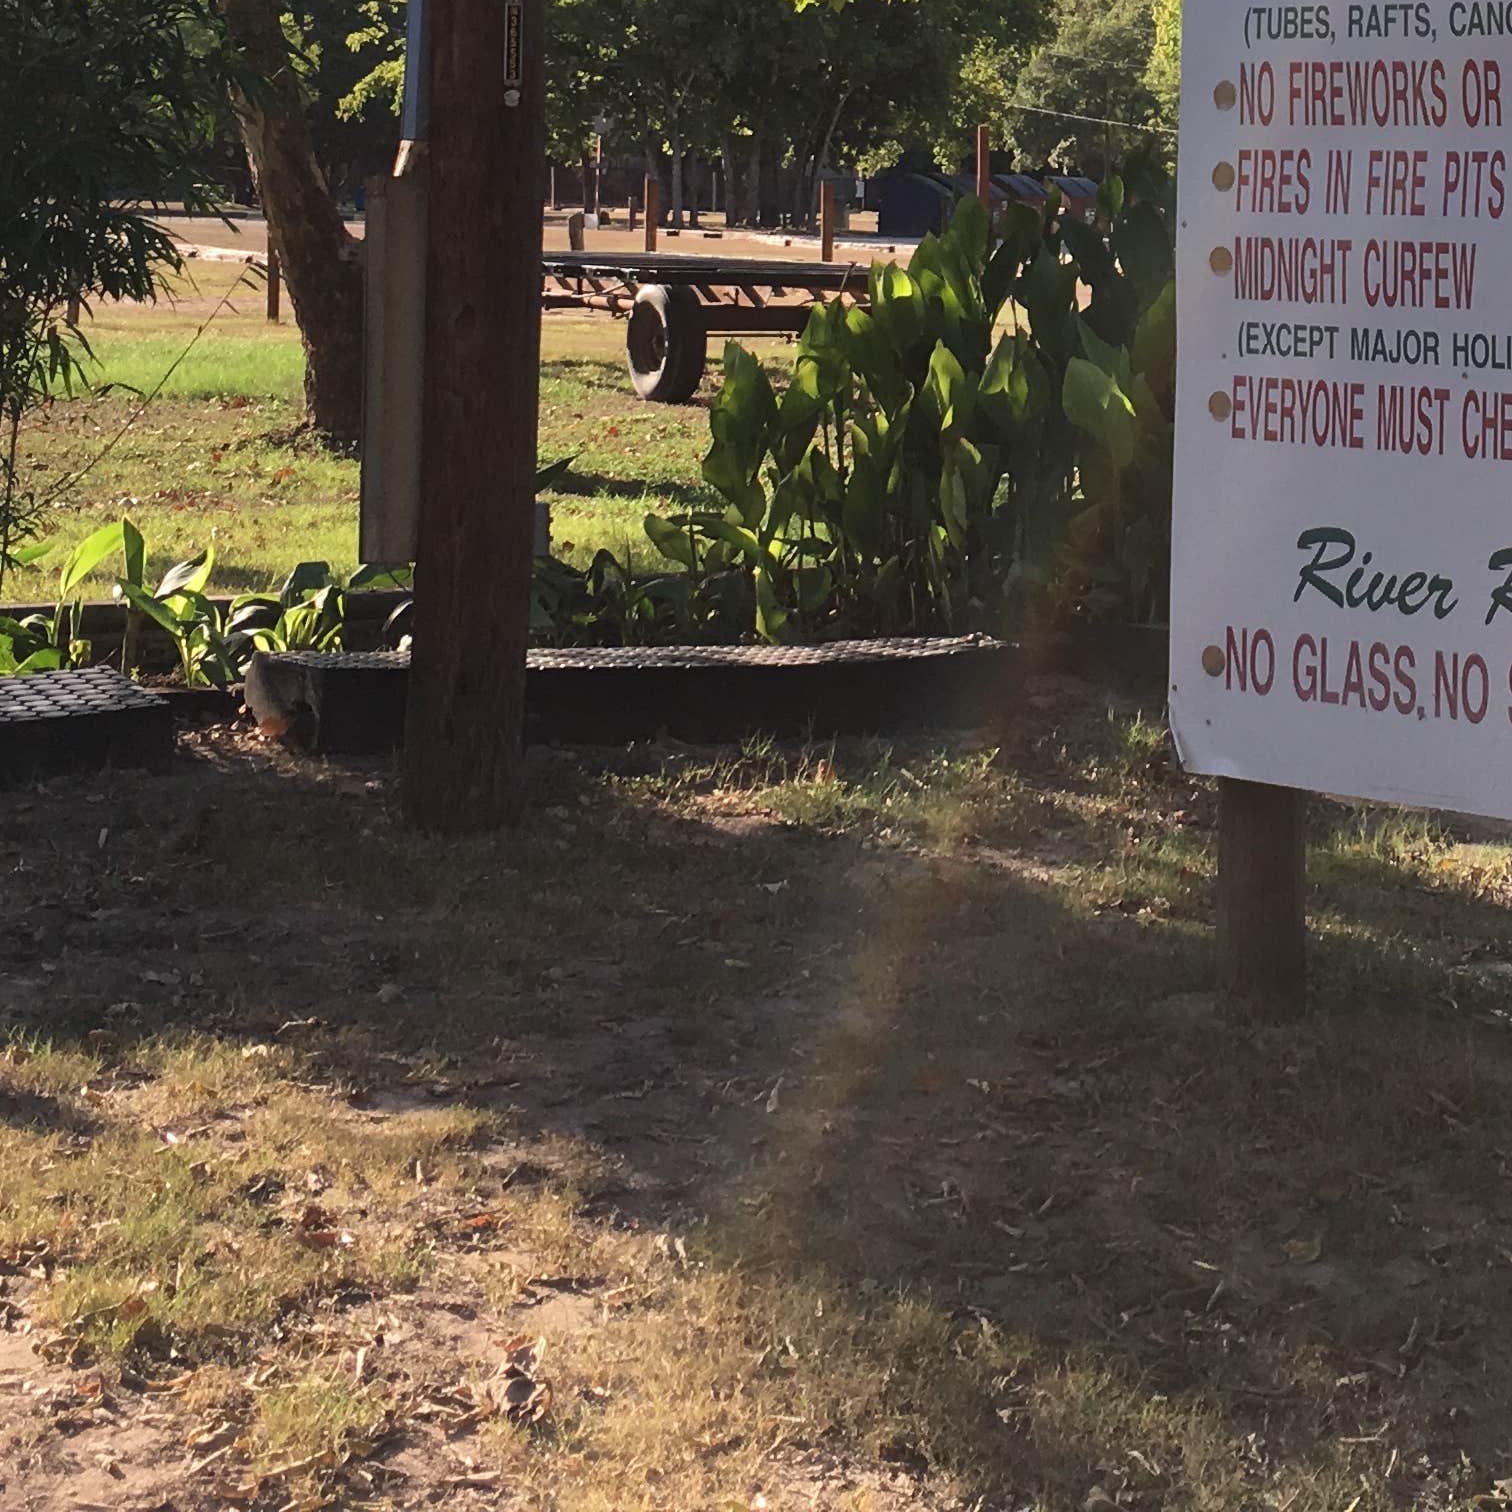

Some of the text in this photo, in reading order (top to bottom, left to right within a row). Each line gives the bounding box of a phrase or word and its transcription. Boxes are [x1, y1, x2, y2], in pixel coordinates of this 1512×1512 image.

[1244, 5, 1335, 49] (TUBES,
[1348, 2, 1436, 43] RAFTS,
[1240, 61, 1274, 126] NO
[1289, 59, 1447, 128] FIREWORKS
[1462, 59, 1502, 128] OR
[1236, 148, 1311, 215] FIRES
[1326, 150, 1352, 215] IN
[1366, 150, 1428, 216] FIRE
[1443, 150, 1506, 219] PITS
[1235, 236, 1476, 310] MIDNIGHT CURFEW
[1238, 321, 1339, 359] (EXCEPT
[1351, 327, 1440, 365] MAJOR
[1231, 375, 1365, 449] EVERYONE
[1377, 384, 1450, 456] MUST
[1293, 527, 1459, 620] River
[1225, 625, 1276, 696] NO
[1433, 650, 1489, 724] NO
